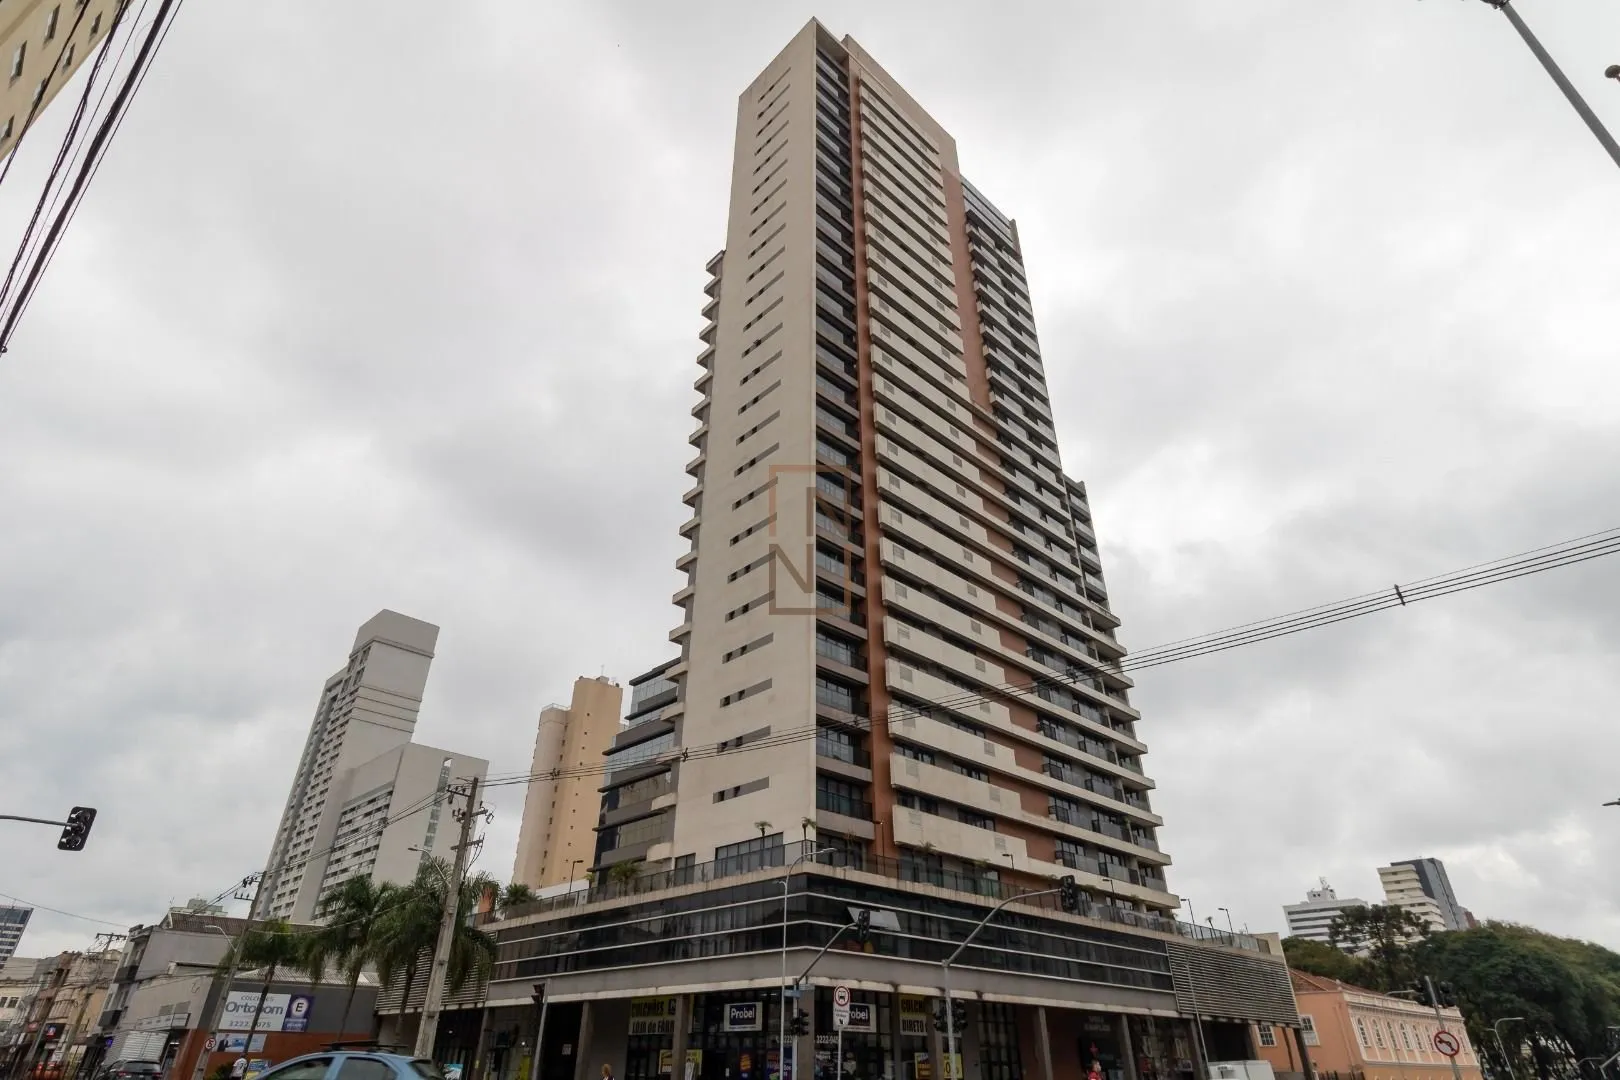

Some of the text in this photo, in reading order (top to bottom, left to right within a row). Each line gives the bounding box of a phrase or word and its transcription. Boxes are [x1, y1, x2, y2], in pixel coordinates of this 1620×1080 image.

[241, 995, 274, 1003] COLCHES
[295, 1002, 304, 1012] E
[730, 1007, 755, 1020] Probel
[848, 1008, 868, 1020] robel
[902, 1019, 924, 1033] DIRETO
